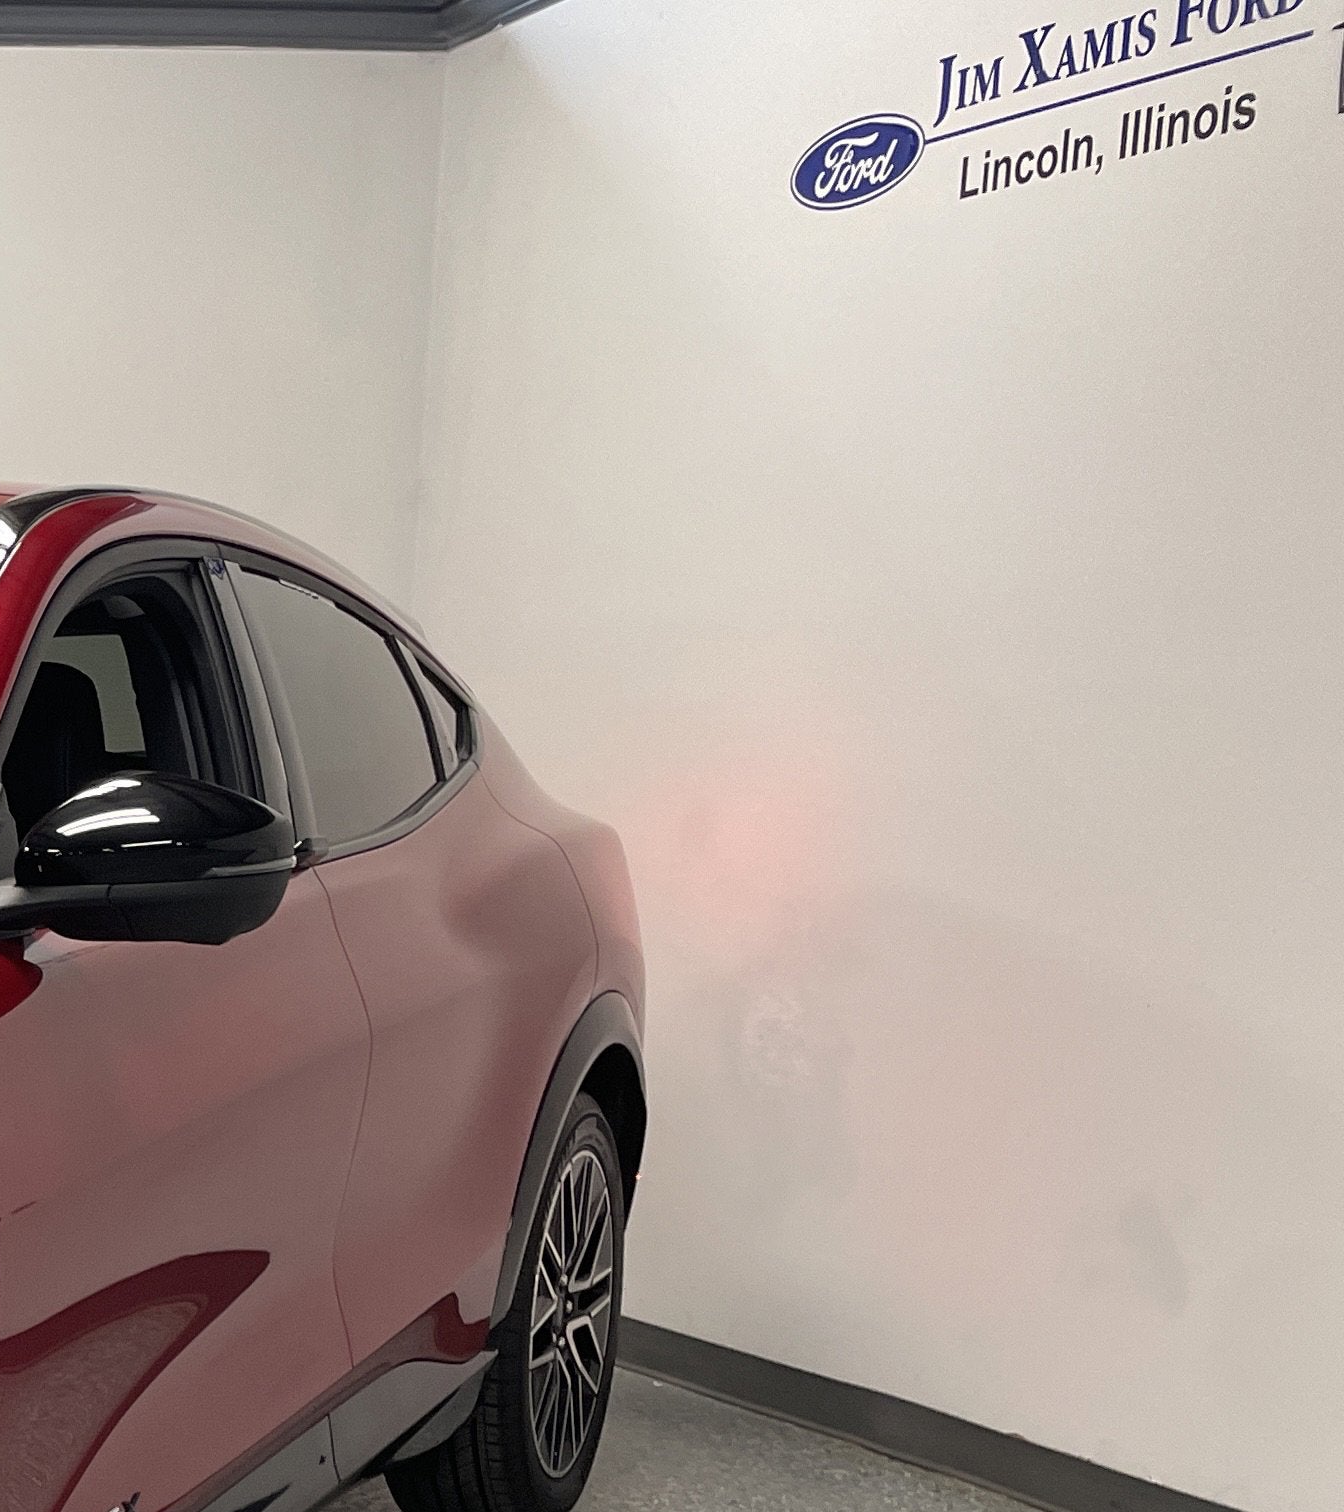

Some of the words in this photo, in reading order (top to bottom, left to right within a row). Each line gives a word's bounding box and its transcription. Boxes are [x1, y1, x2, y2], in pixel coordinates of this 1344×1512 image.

[932, 53, 1005, 129] JIM
[1012, 8, 1157, 94] XAMIS
[812, 134, 895, 200] Ford
[959, 127, 1104, 200] Lincoln,
[1118, 84, 1257, 161] Illinois
